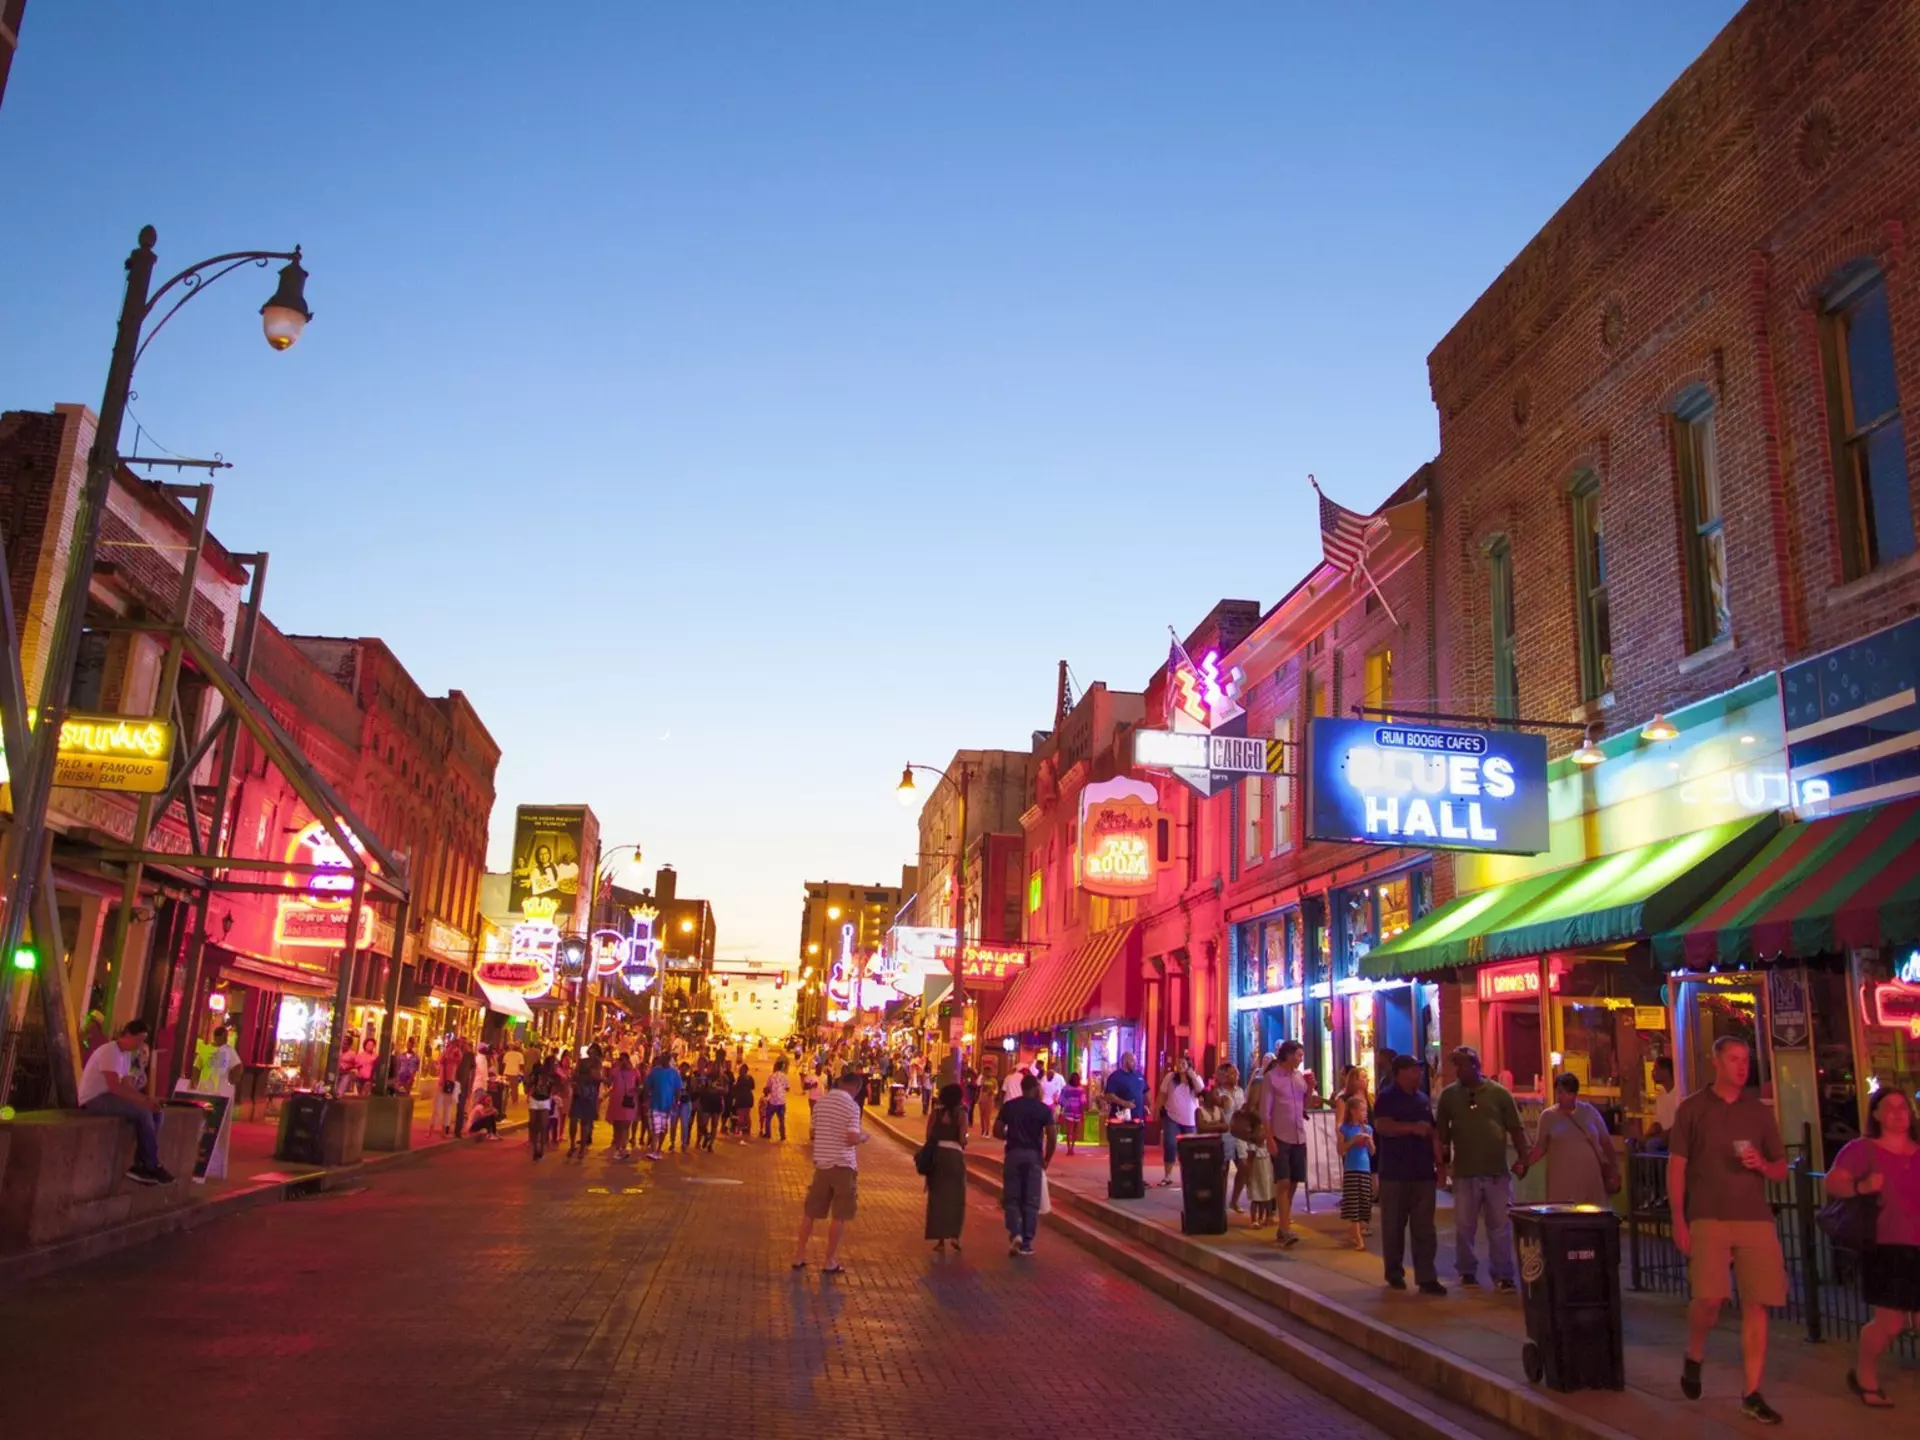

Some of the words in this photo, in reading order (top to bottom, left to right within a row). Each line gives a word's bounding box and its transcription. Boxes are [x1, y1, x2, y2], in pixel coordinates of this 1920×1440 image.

[1381, 730, 1404, 745] RUM
[1406, 733, 1444, 748] BOOGIE
[1446, 736, 1481, 751] CAFE'S
[1213, 738, 1263, 769] CARGO
[58, 770, 94, 782] IRISH
[98, 774, 125, 785] BAR
[99, 762, 154, 776] FAMOUS
[1366, 796, 1498, 842] HALL
[979, 950, 1026, 965] PALACE
